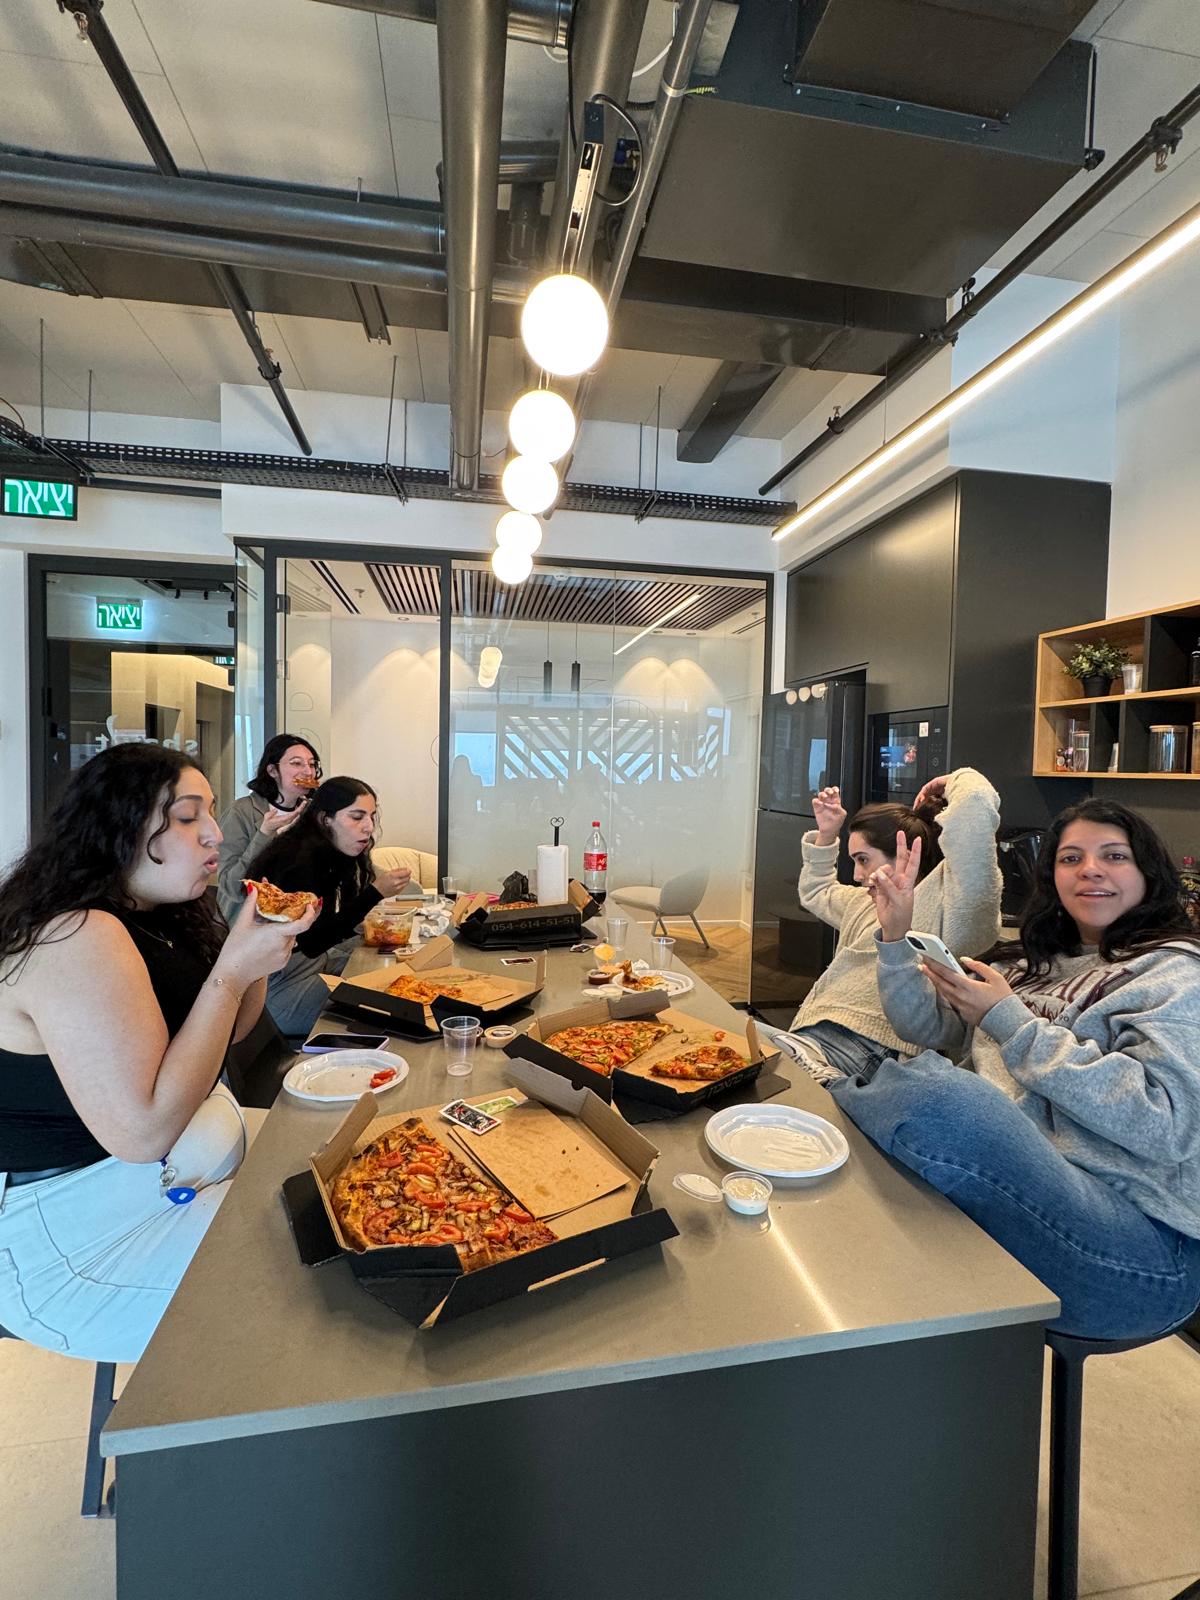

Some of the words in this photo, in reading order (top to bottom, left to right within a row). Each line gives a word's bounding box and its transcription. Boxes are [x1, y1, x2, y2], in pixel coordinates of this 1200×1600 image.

[4, 479, 74, 516] יציאה
[98, 604, 140, 628] יציאה
[491, 916, 575, 932] 054-614-51-51
